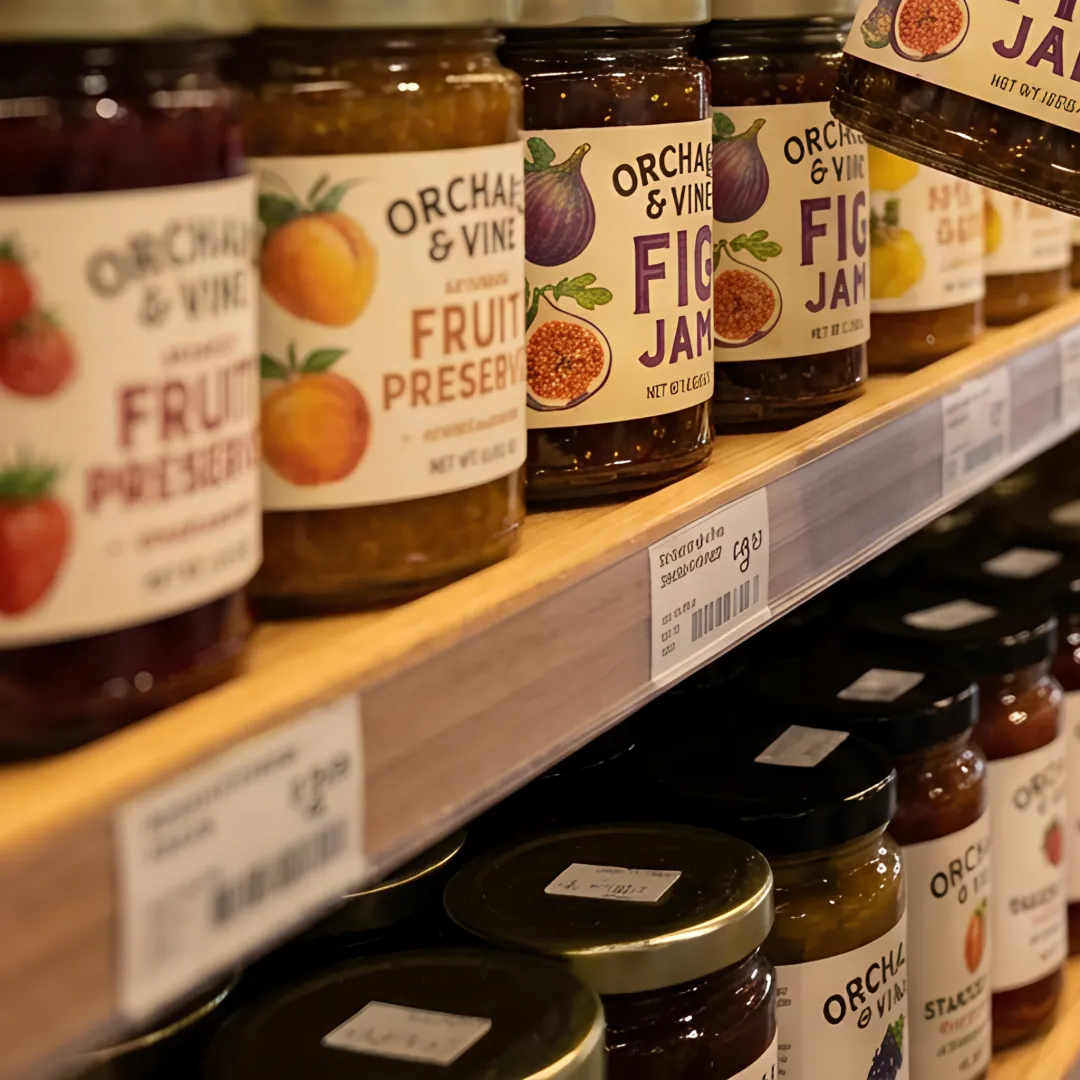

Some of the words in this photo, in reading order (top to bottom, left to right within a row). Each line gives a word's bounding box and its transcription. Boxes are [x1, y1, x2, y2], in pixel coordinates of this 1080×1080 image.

[646, 189, 667, 220] &
[671, 181, 712, 216] VINE
[800, 190, 867, 267] FIG
[429, 228, 453, 262] &
[461, 216, 515, 258] VINE
[633, 224, 712, 316] FIG
[805, 262, 866, 313] JAM
[411, 292, 520, 360] FRUIT
[638, 308, 712, 368] JAM
